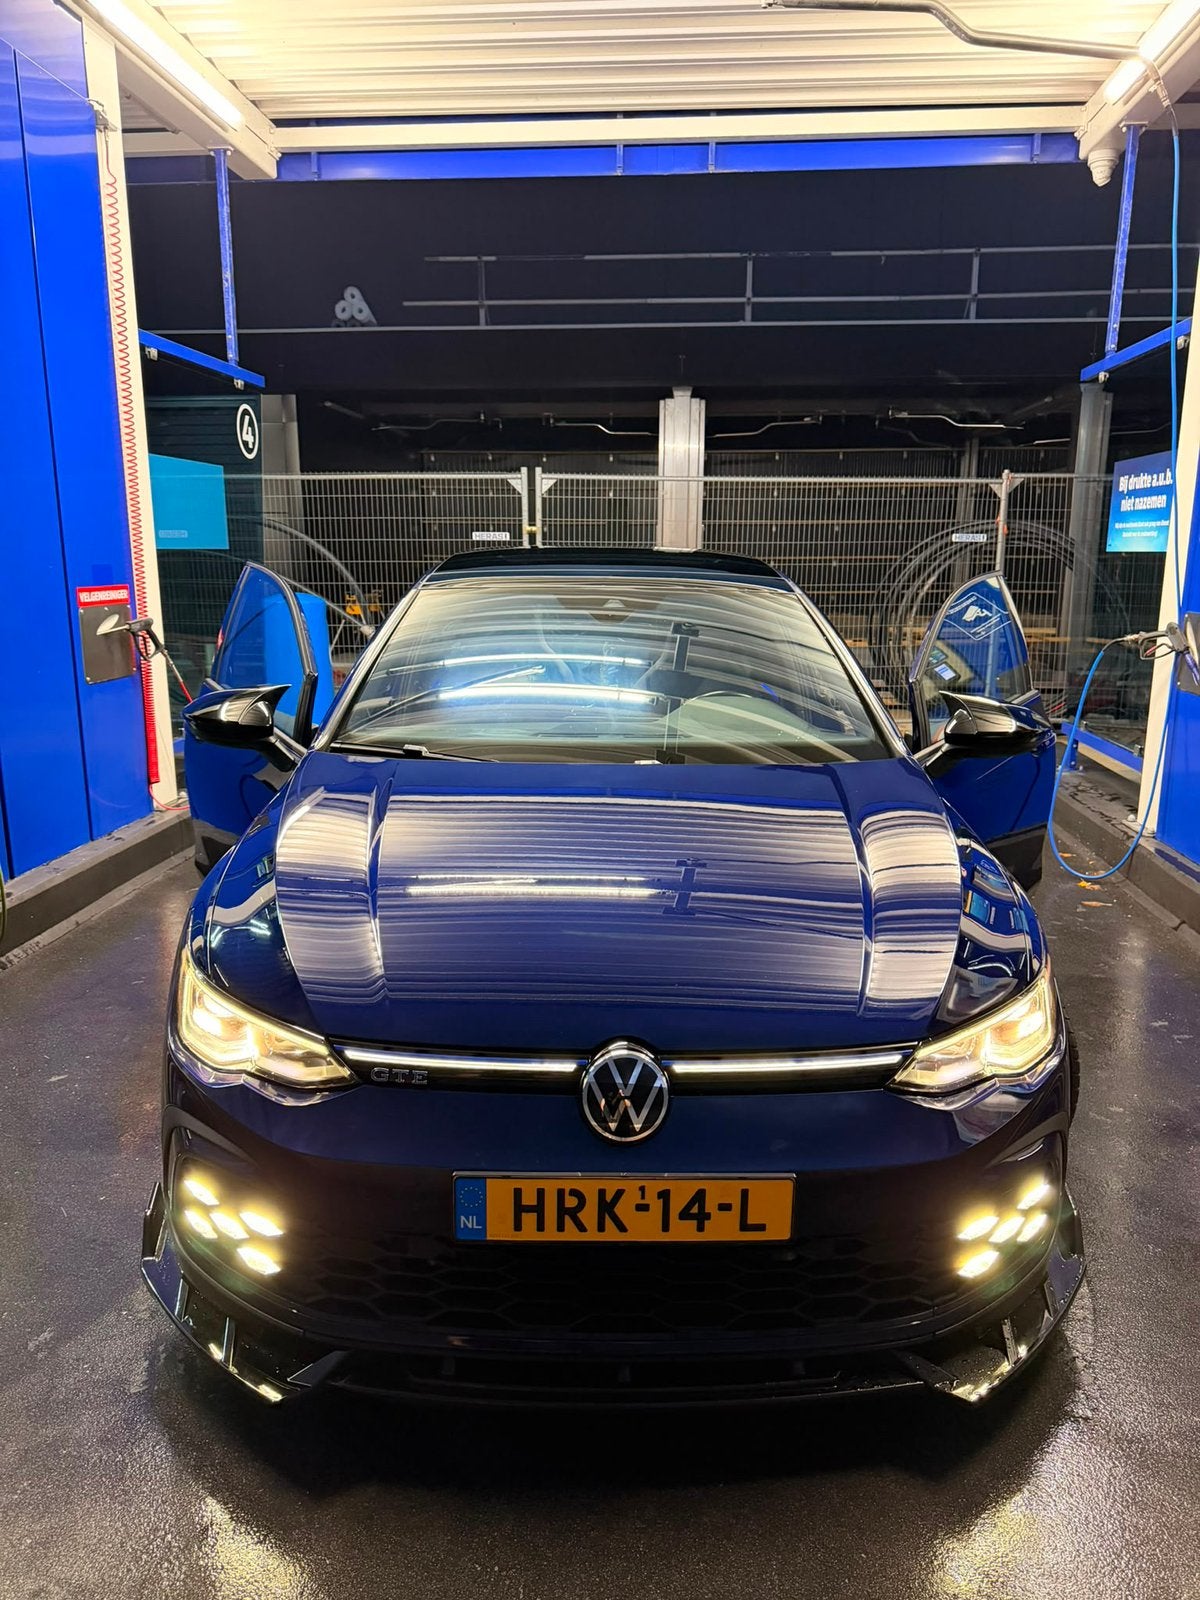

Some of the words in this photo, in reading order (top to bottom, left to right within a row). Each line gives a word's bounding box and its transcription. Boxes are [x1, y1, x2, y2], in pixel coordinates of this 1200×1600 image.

[242, 414, 254, 449] 4
[1119, 475, 1129, 494] Bij
[1129, 472, 1152, 490] drukte
[1152, 468, 1173, 487] a.u.b.
[1121, 496, 1134, 512] niet
[370, 1066, 429, 1085] GTE
[459, 1215, 482, 1230] NL
